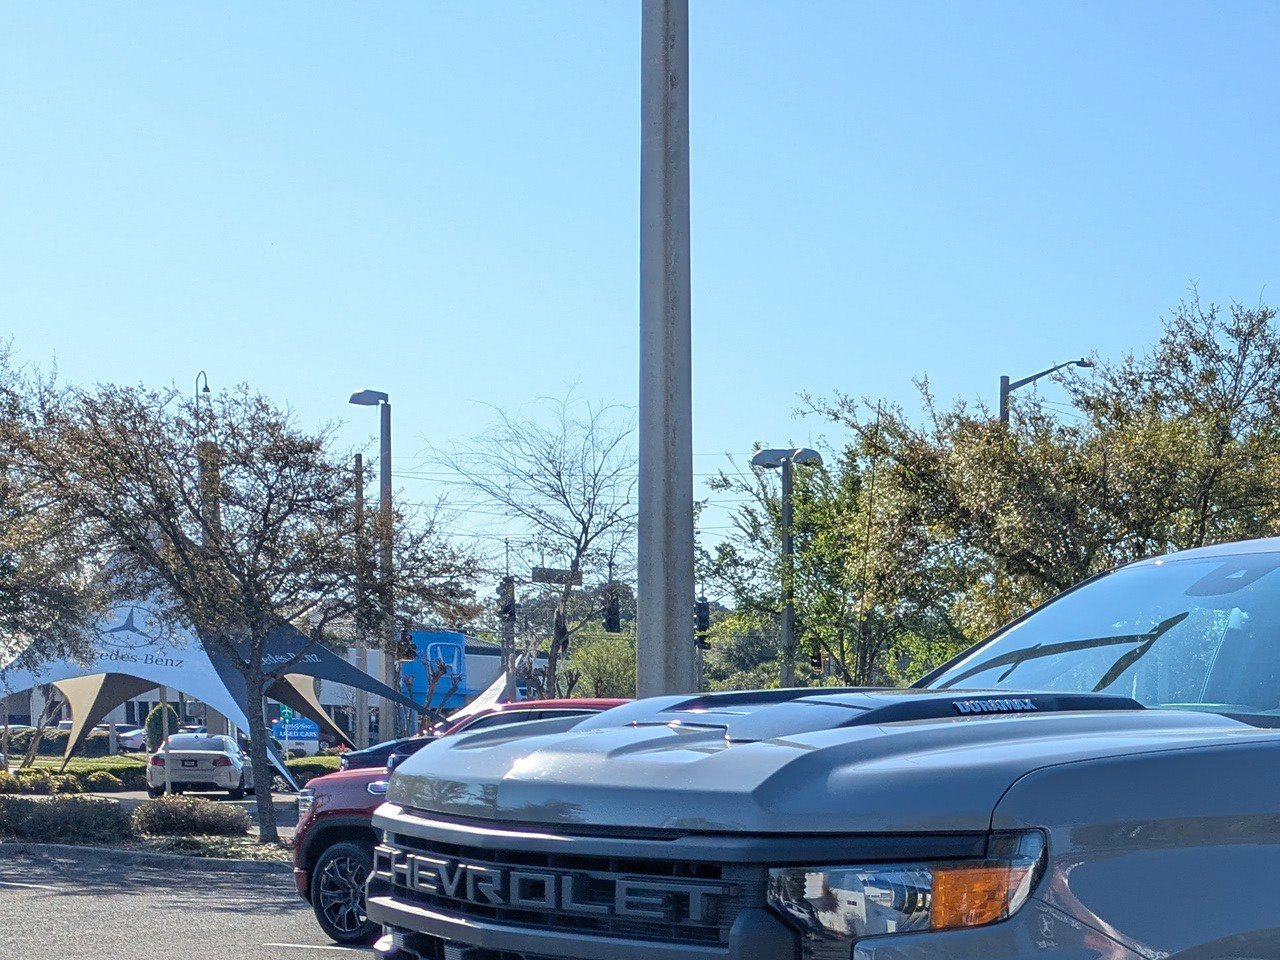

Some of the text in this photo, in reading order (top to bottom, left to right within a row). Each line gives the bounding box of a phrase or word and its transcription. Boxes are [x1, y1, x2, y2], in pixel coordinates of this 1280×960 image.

[90, 649, 184, 669] cedes-Benz
[953, 699, 1037, 713] DURAMAX
[374, 844, 723, 922] CHEVROLET
